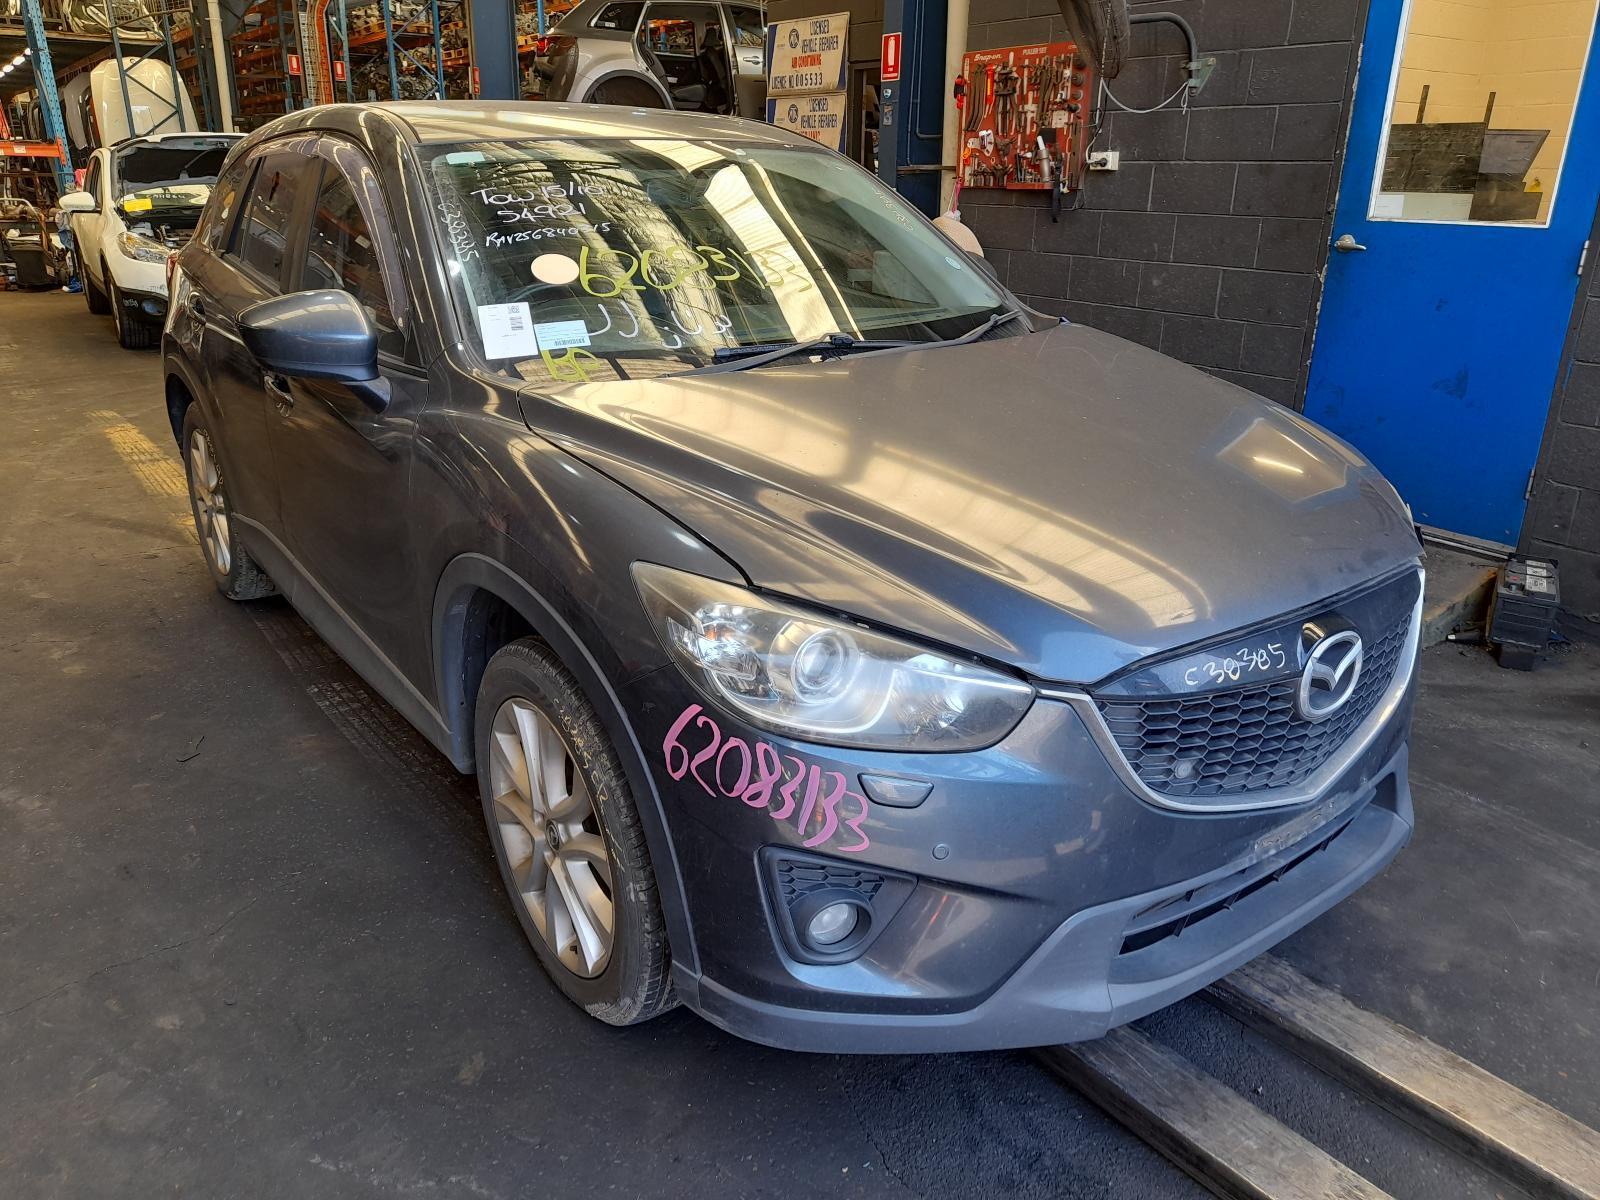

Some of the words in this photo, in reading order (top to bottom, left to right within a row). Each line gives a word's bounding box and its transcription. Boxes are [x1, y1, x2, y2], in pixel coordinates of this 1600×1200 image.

[801, 37, 818, 54] VEHICLE
[818, 35, 839, 52] REPAIRER
[795, 72, 823, 88] 005533
[800, 114, 817, 129] VEHICLE
[817, 113, 838, 128] REPAIRER
[662, 703, 870, 853] 62083133
